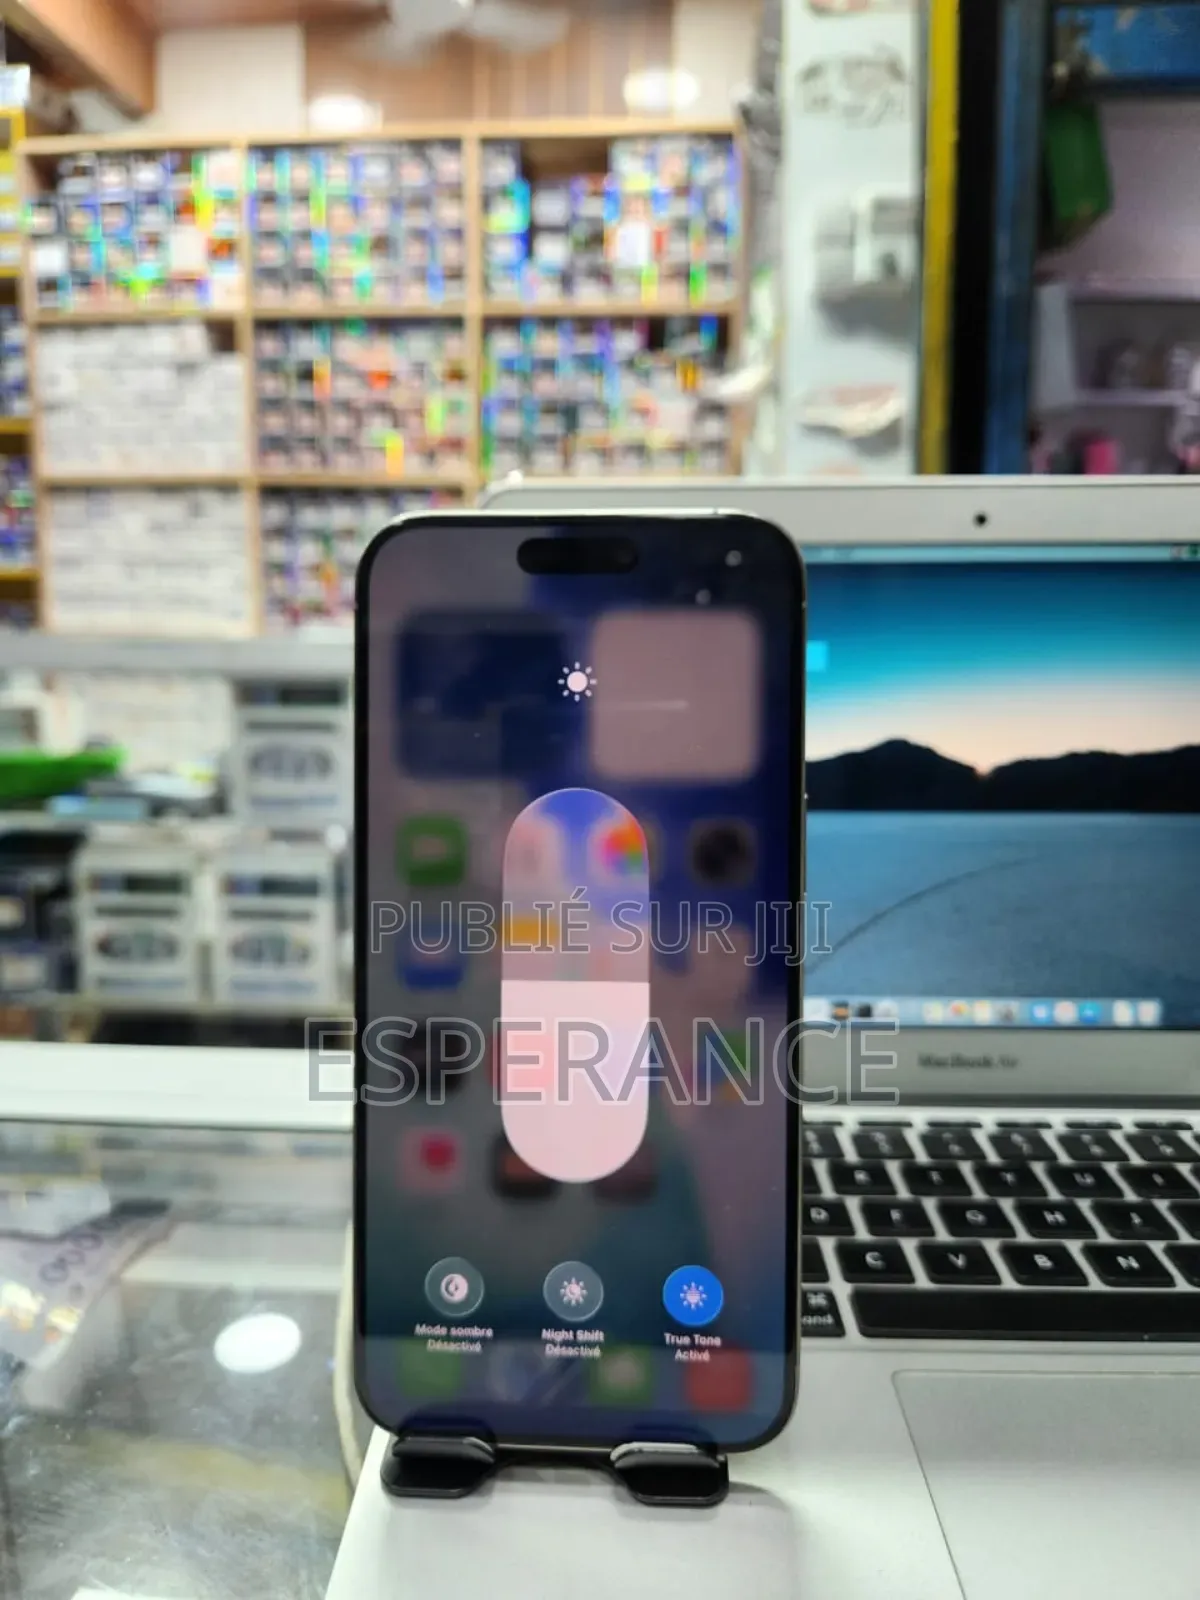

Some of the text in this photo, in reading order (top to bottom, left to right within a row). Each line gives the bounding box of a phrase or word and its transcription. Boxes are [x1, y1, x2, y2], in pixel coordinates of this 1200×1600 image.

[1043, 1210, 1067, 1227] H
[865, 1251, 1141, 1272] C V B N
[414, 1322, 494, 1339] Mode sombre
[541, 1328, 605, 1343] Night Shift
[664, 1332, 722, 1347] True Tone
[674, 1347, 711, 1362] Activé
